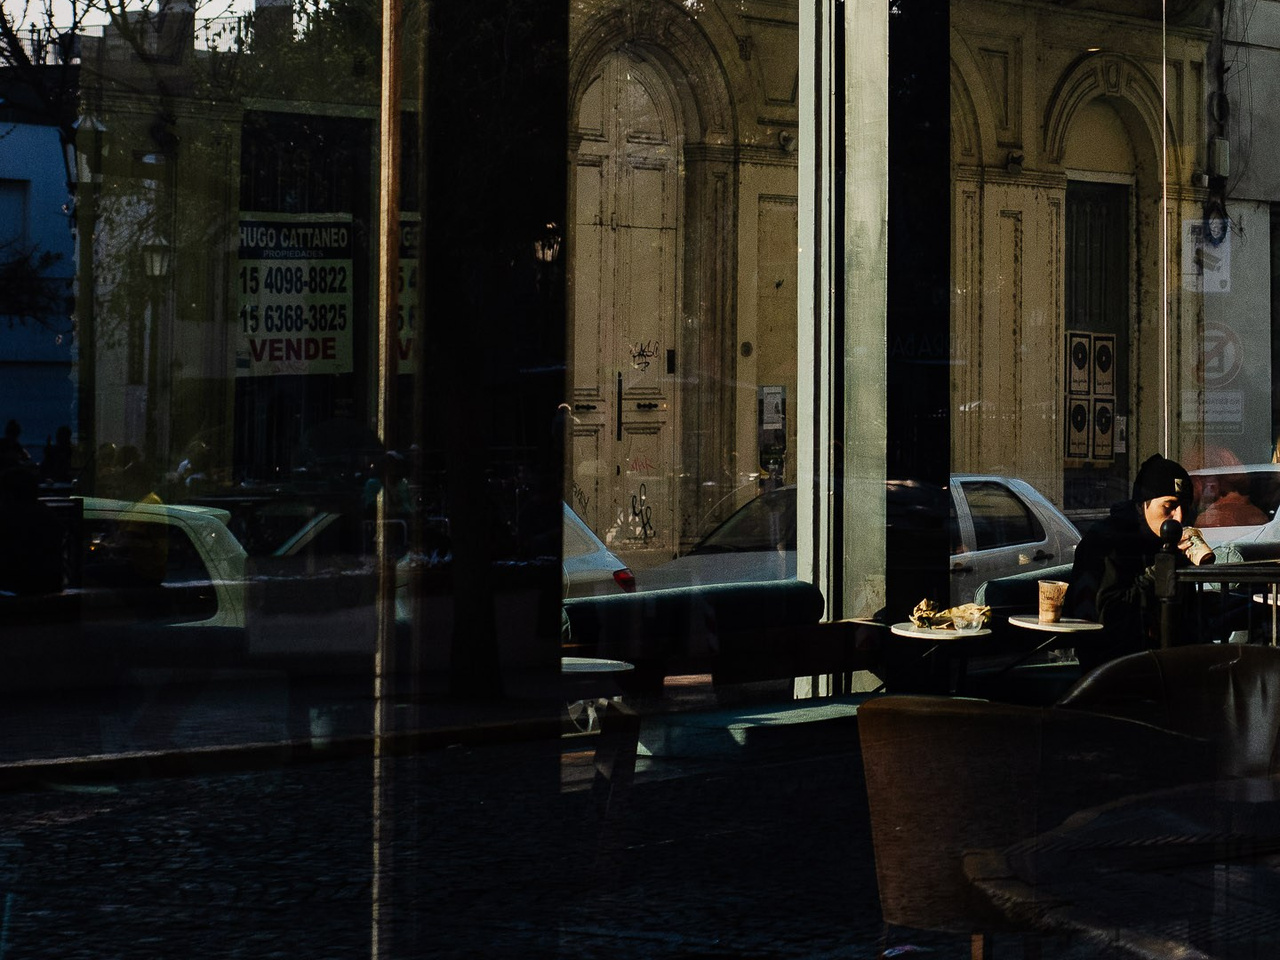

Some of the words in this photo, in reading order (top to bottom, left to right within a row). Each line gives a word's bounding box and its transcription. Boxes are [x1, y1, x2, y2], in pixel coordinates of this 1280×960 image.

[239, 226, 276, 248] HUGO
[280, 226, 348, 248] CATTANEO
[263, 249, 324, 259] PROPIEDADES
[240, 266, 259, 294] 15
[264, 266, 347, 294] 4098-8822
[240, 305, 259, 332] 15
[264, 304, 347, 332] 6368-3825
[250, 337, 336, 362] VENDE
